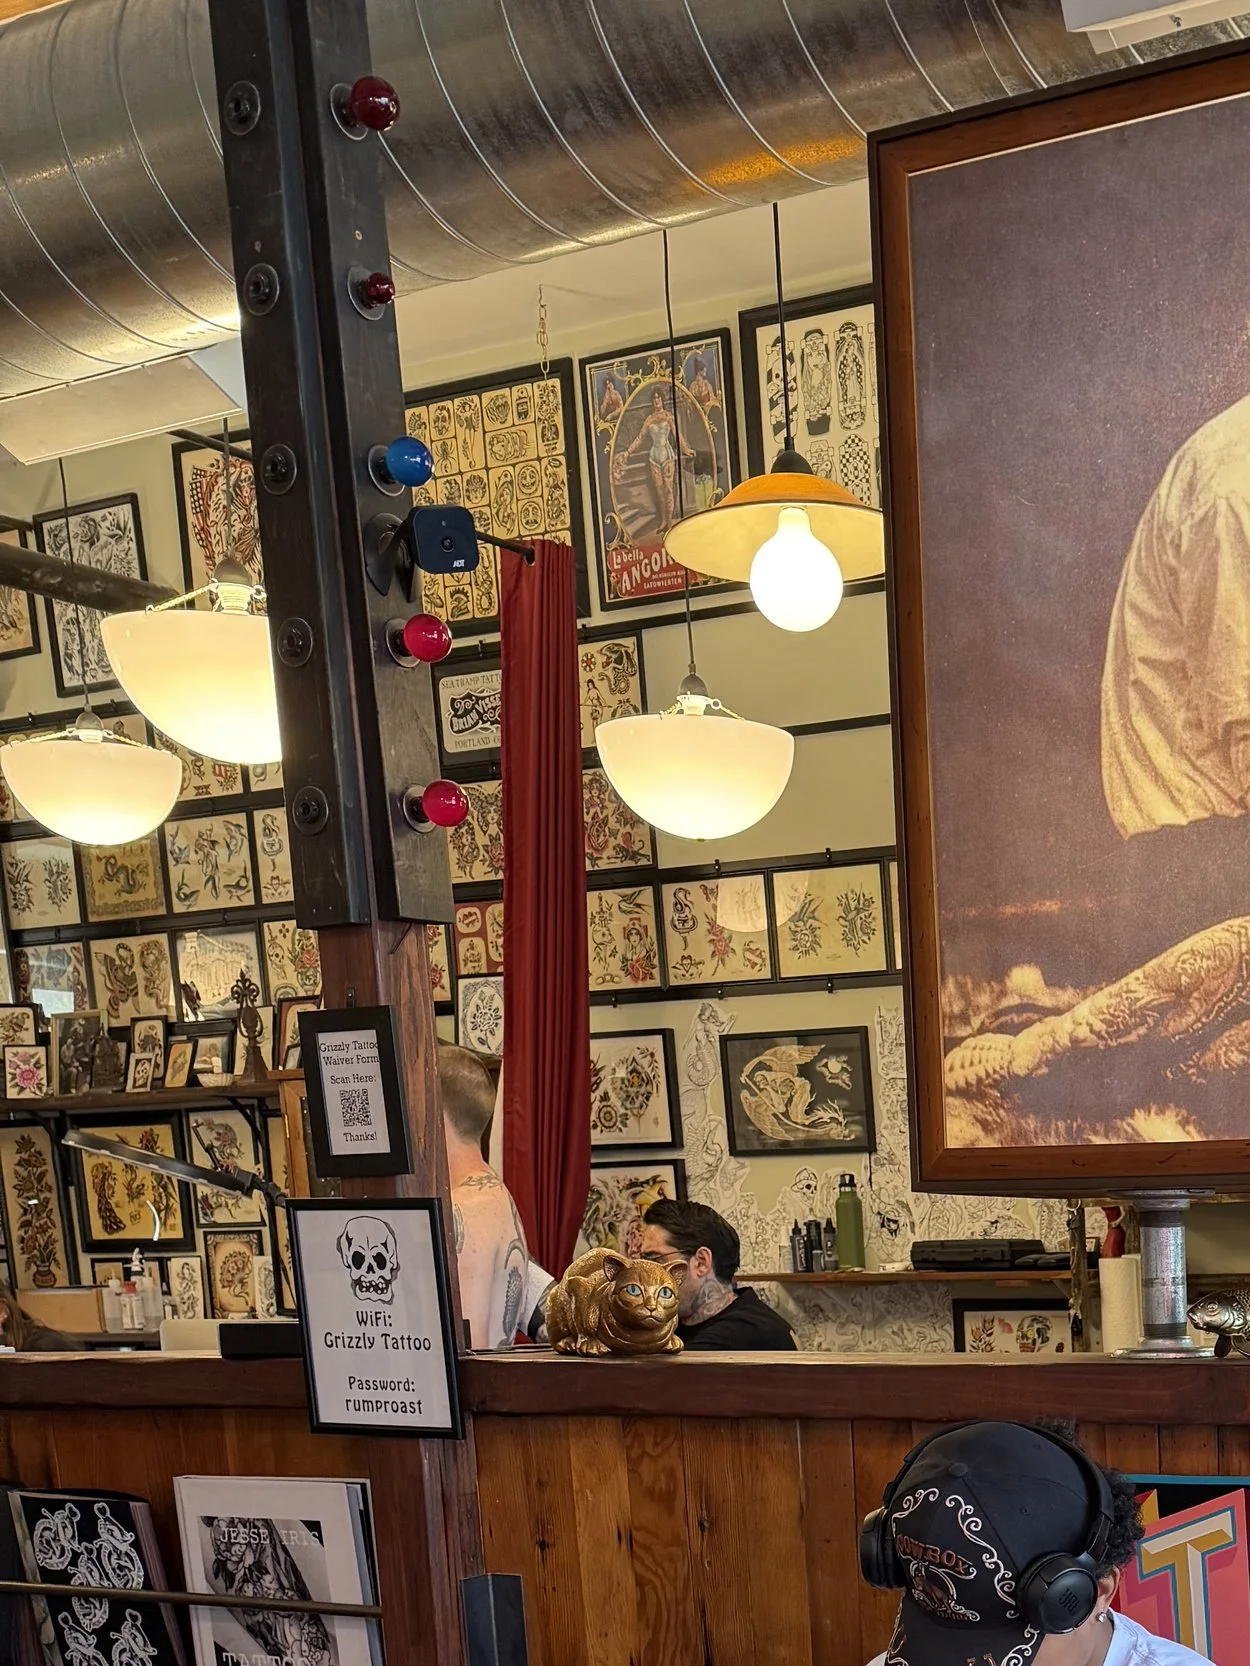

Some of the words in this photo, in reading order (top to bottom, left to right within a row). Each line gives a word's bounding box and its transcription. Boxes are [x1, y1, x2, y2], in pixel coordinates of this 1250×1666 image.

[622, 547, 676, 594] ANGOR
[480, 672, 501, 685] TATT
[451, 709, 480, 732] BRIAN
[474, 693, 501, 713] VISSE
[319, 1042, 350, 1054] Grizzly
[322, 1056, 354, 1066] Waiver
[355, 1054, 380, 1064] Form
[330, 1074, 351, 1085] Scan
[352, 1073, 377, 1083] Here:
[343, 1131, 378, 1143] Thanks!
[355, 1310, 393, 1327] WiFi:
[323, 1331, 375, 1350] Grizzly
[380, 1332, 432, 1351] Tattoo
[348, 1375, 416, 1393] Password:
[345, 1398, 423, 1415] rumproast
[220, 1527, 271, 1545] JESSE
[281, 1530, 320, 1546] IRIS
[895, 1534, 974, 1575] COWBOY
